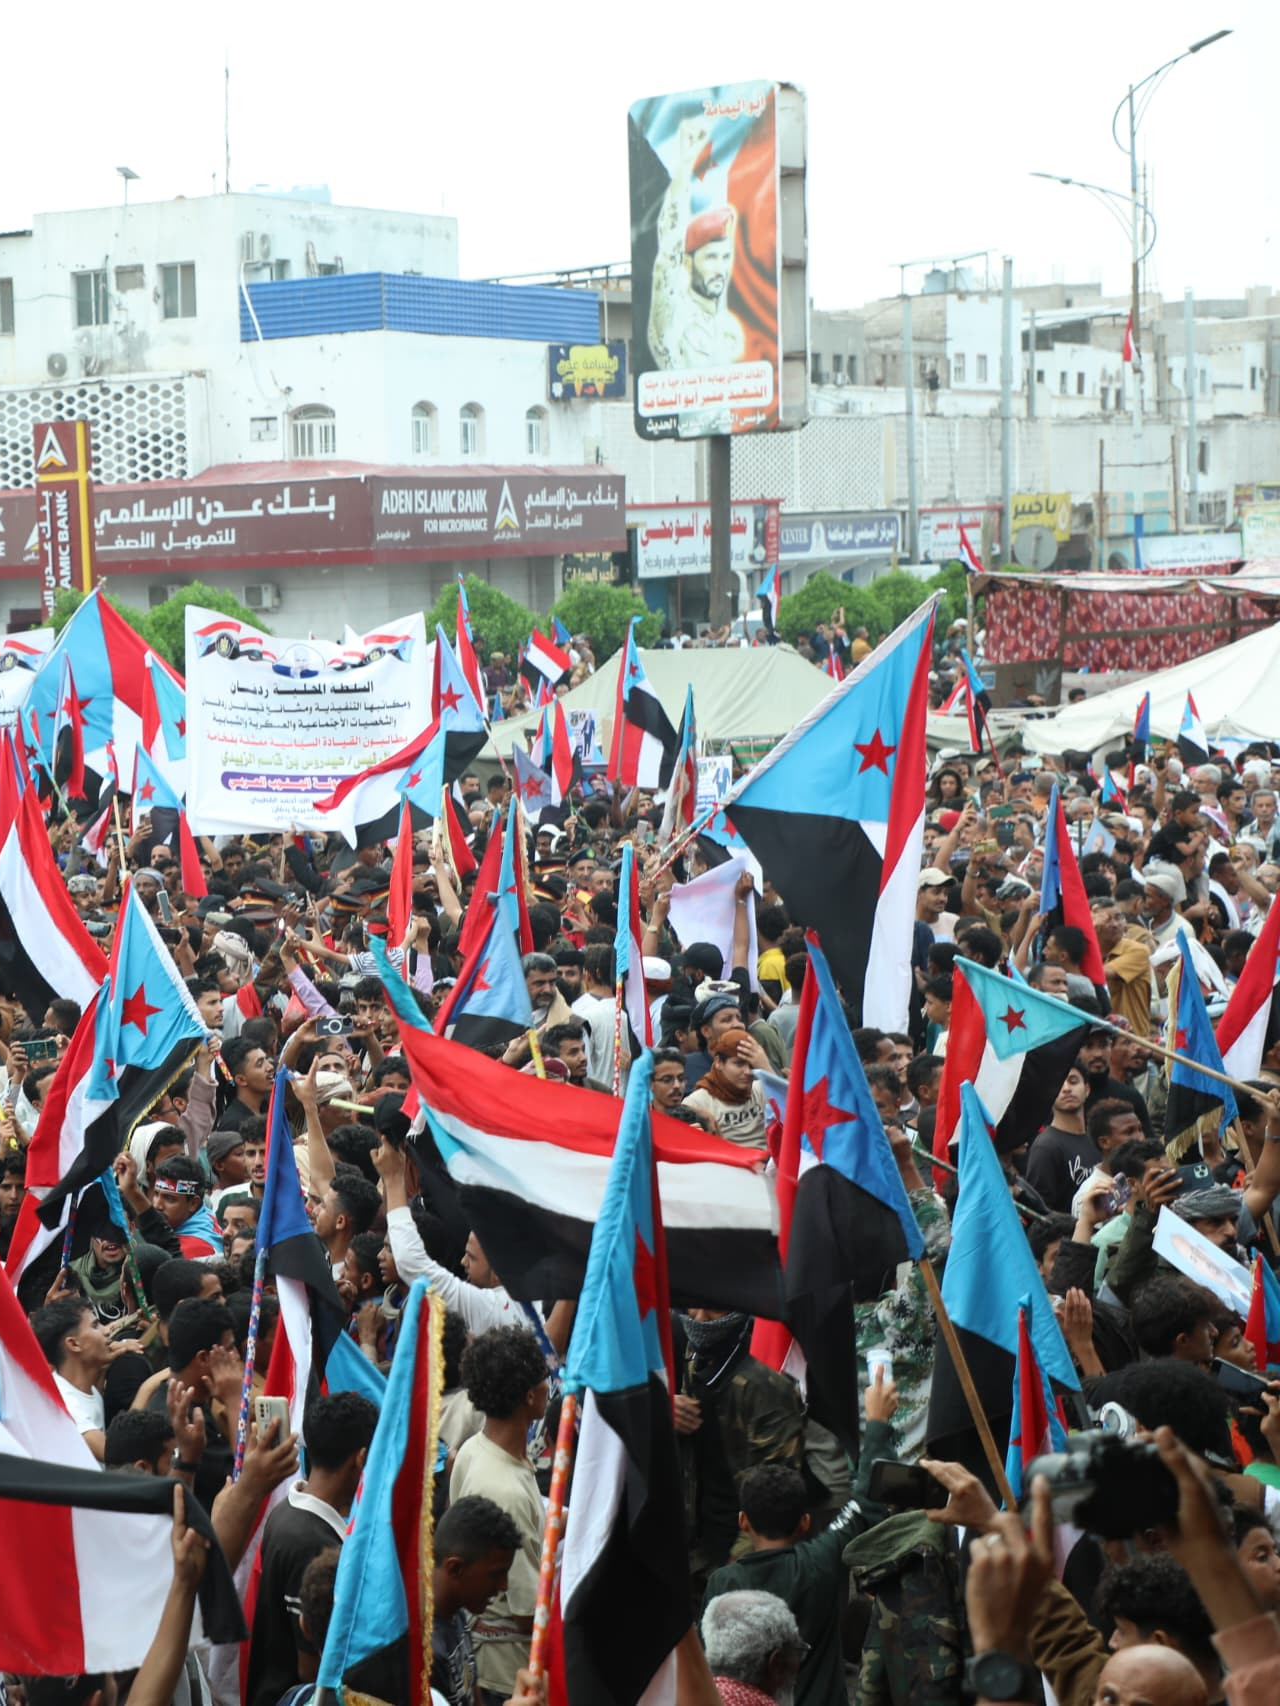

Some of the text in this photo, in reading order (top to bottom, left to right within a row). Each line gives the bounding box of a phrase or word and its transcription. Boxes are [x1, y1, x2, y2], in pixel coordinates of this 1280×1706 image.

[646, 418, 677, 435] الحديث
[267, 487, 336, 520] بنك
[381, 488, 488, 515] ADEN ISLAMIC BANK
[566, 490, 593, 510] عدن
[593, 483, 619, 511] بنك
[56, 490, 70, 543] BANK
[197, 496, 263, 526] عدن
[423, 518, 488, 533] FOR MICROFINANCE
[162, 528, 236, 550] للتمويل
[231, 680, 374, 698] السلطة المحلية ردفان
[315, 701, 362, 714] التنفيذية
[270, 735, 320, 748] السياسية
[323, 735, 361, 746] القيادة
[258, 753, 283, 766] قاسم
[285, 755, 300, 769] بن
[302, 757, 346, 770] عيدروس
[228, 776, 267, 791] العربي
[269, 776, 312, 791] الجنوب
